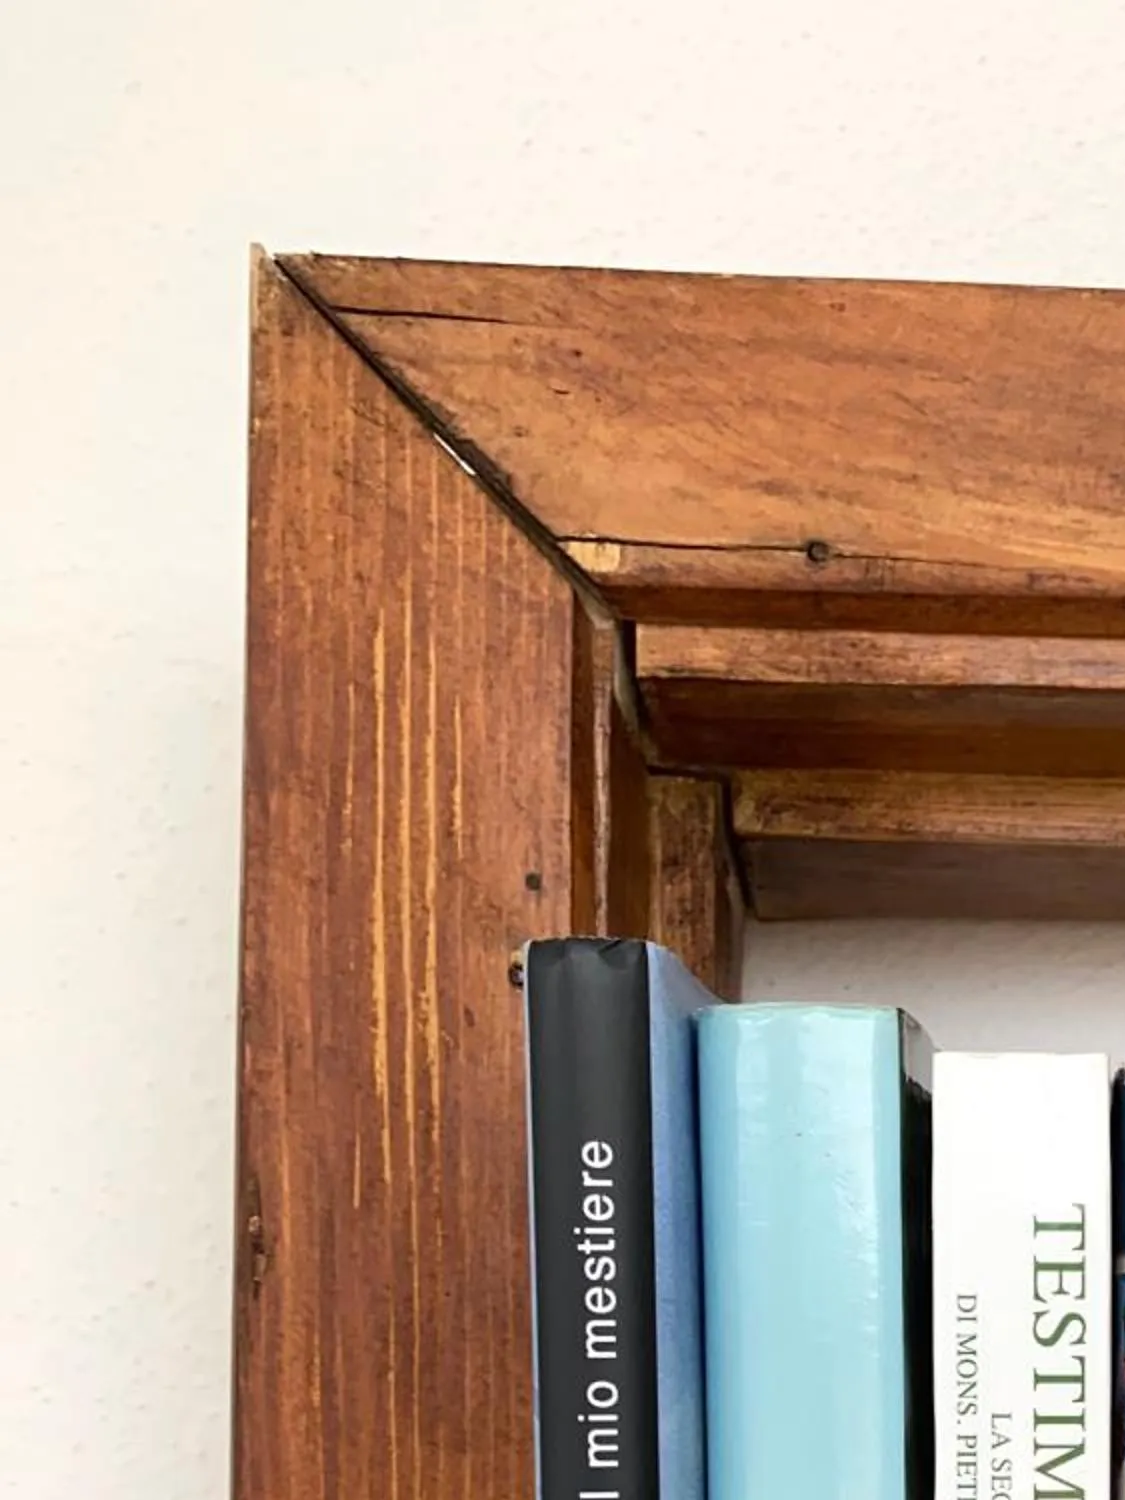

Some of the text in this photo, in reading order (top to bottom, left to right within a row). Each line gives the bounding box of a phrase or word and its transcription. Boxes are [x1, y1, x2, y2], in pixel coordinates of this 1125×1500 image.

[574, 1139, 618, 1361] mestiere
[954, 1293, 978, 1324] DI
[954, 1331, 978, 1425] MONS.
[578, 1380, 620, 1468] mio
[989, 1412, 1012, 1453] LA
